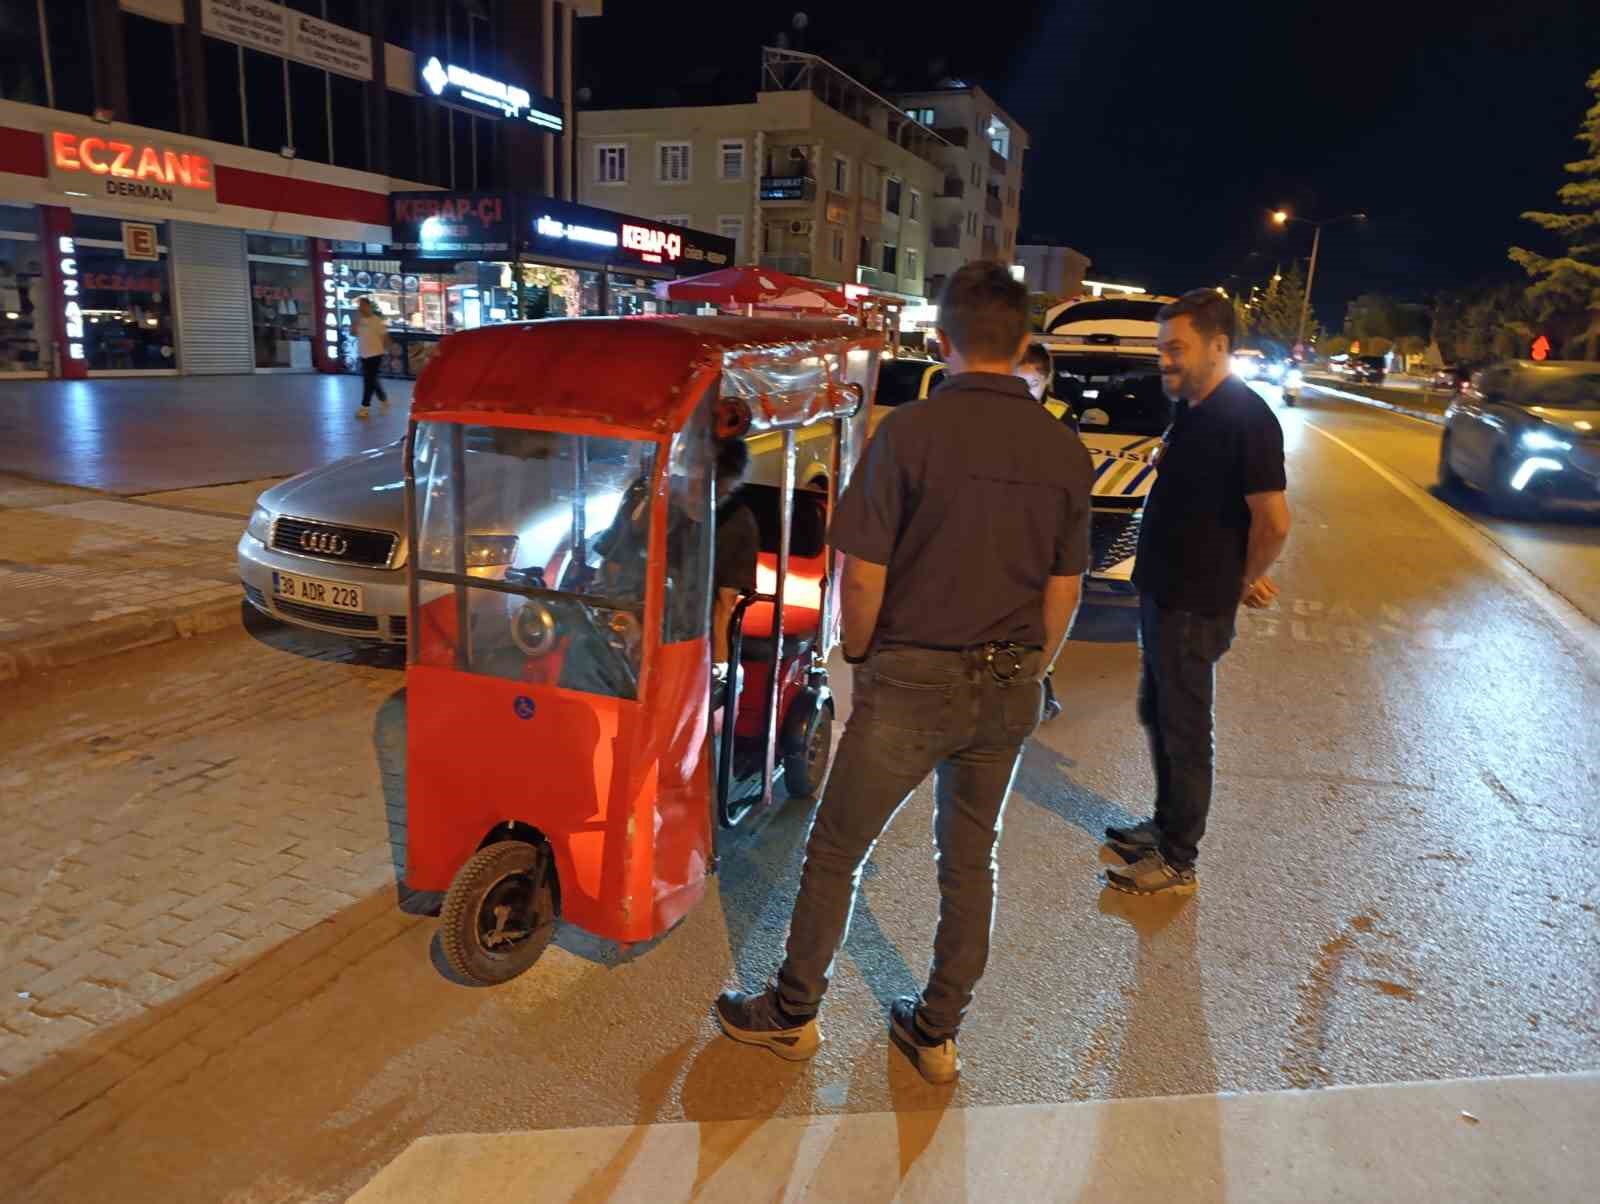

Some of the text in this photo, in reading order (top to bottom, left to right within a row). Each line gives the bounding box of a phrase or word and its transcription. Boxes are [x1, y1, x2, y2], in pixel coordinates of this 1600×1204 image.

[52, 131, 214, 189] ECZANE
[106, 180, 173, 201] DERMAN
[134, 230, 150, 250] E
[622, 224, 681, 260] KEBAP-ÇI
[59, 236, 85, 359] ECZANE
[323, 262, 338, 359] ECZANE
[280, 576, 359, 608] 38 ADR 228
